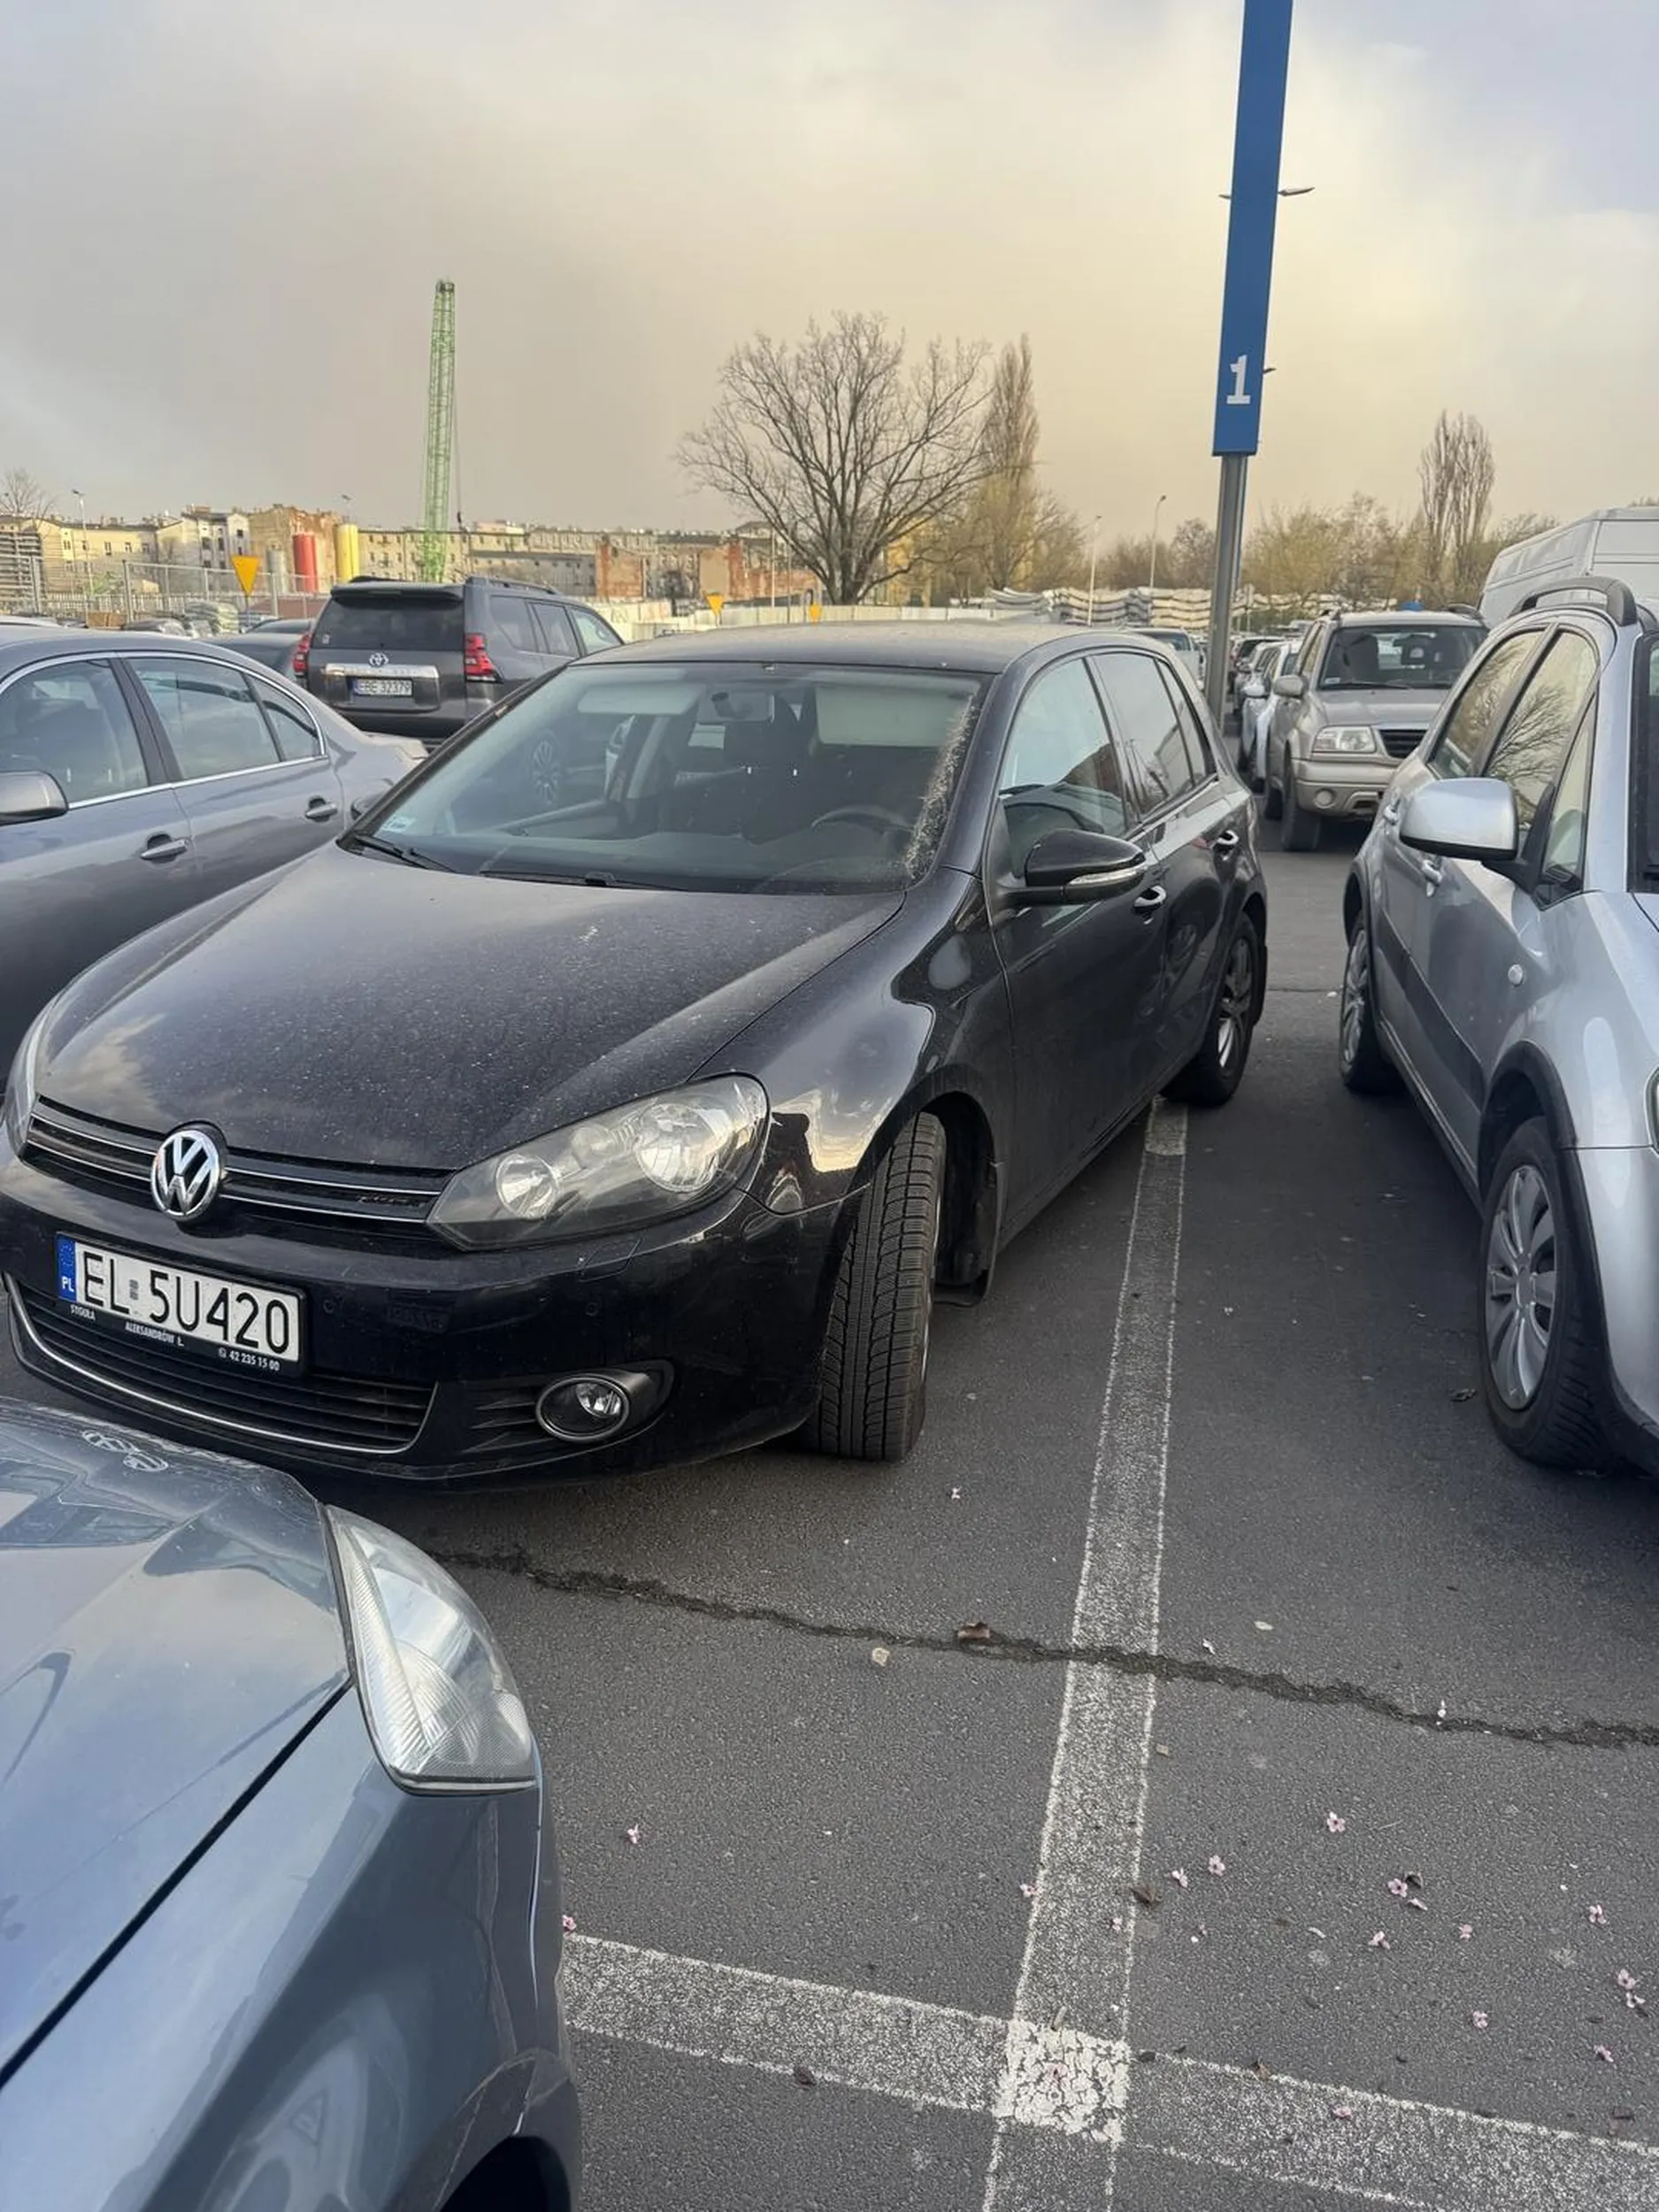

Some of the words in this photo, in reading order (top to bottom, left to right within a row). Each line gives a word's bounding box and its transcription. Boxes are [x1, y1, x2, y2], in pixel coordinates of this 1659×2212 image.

[1226, 355, 1251, 404] 1
[61, 1276, 74, 1293] PL
[83, 1251, 130, 1315] EL
[150, 1269, 289, 1354] 5U420
[229, 1349, 240, 1362] 42
[241, 1352, 257, 1365] 235
[257, 1356, 268, 1369] 15
[268, 1360, 280, 1371] 00
